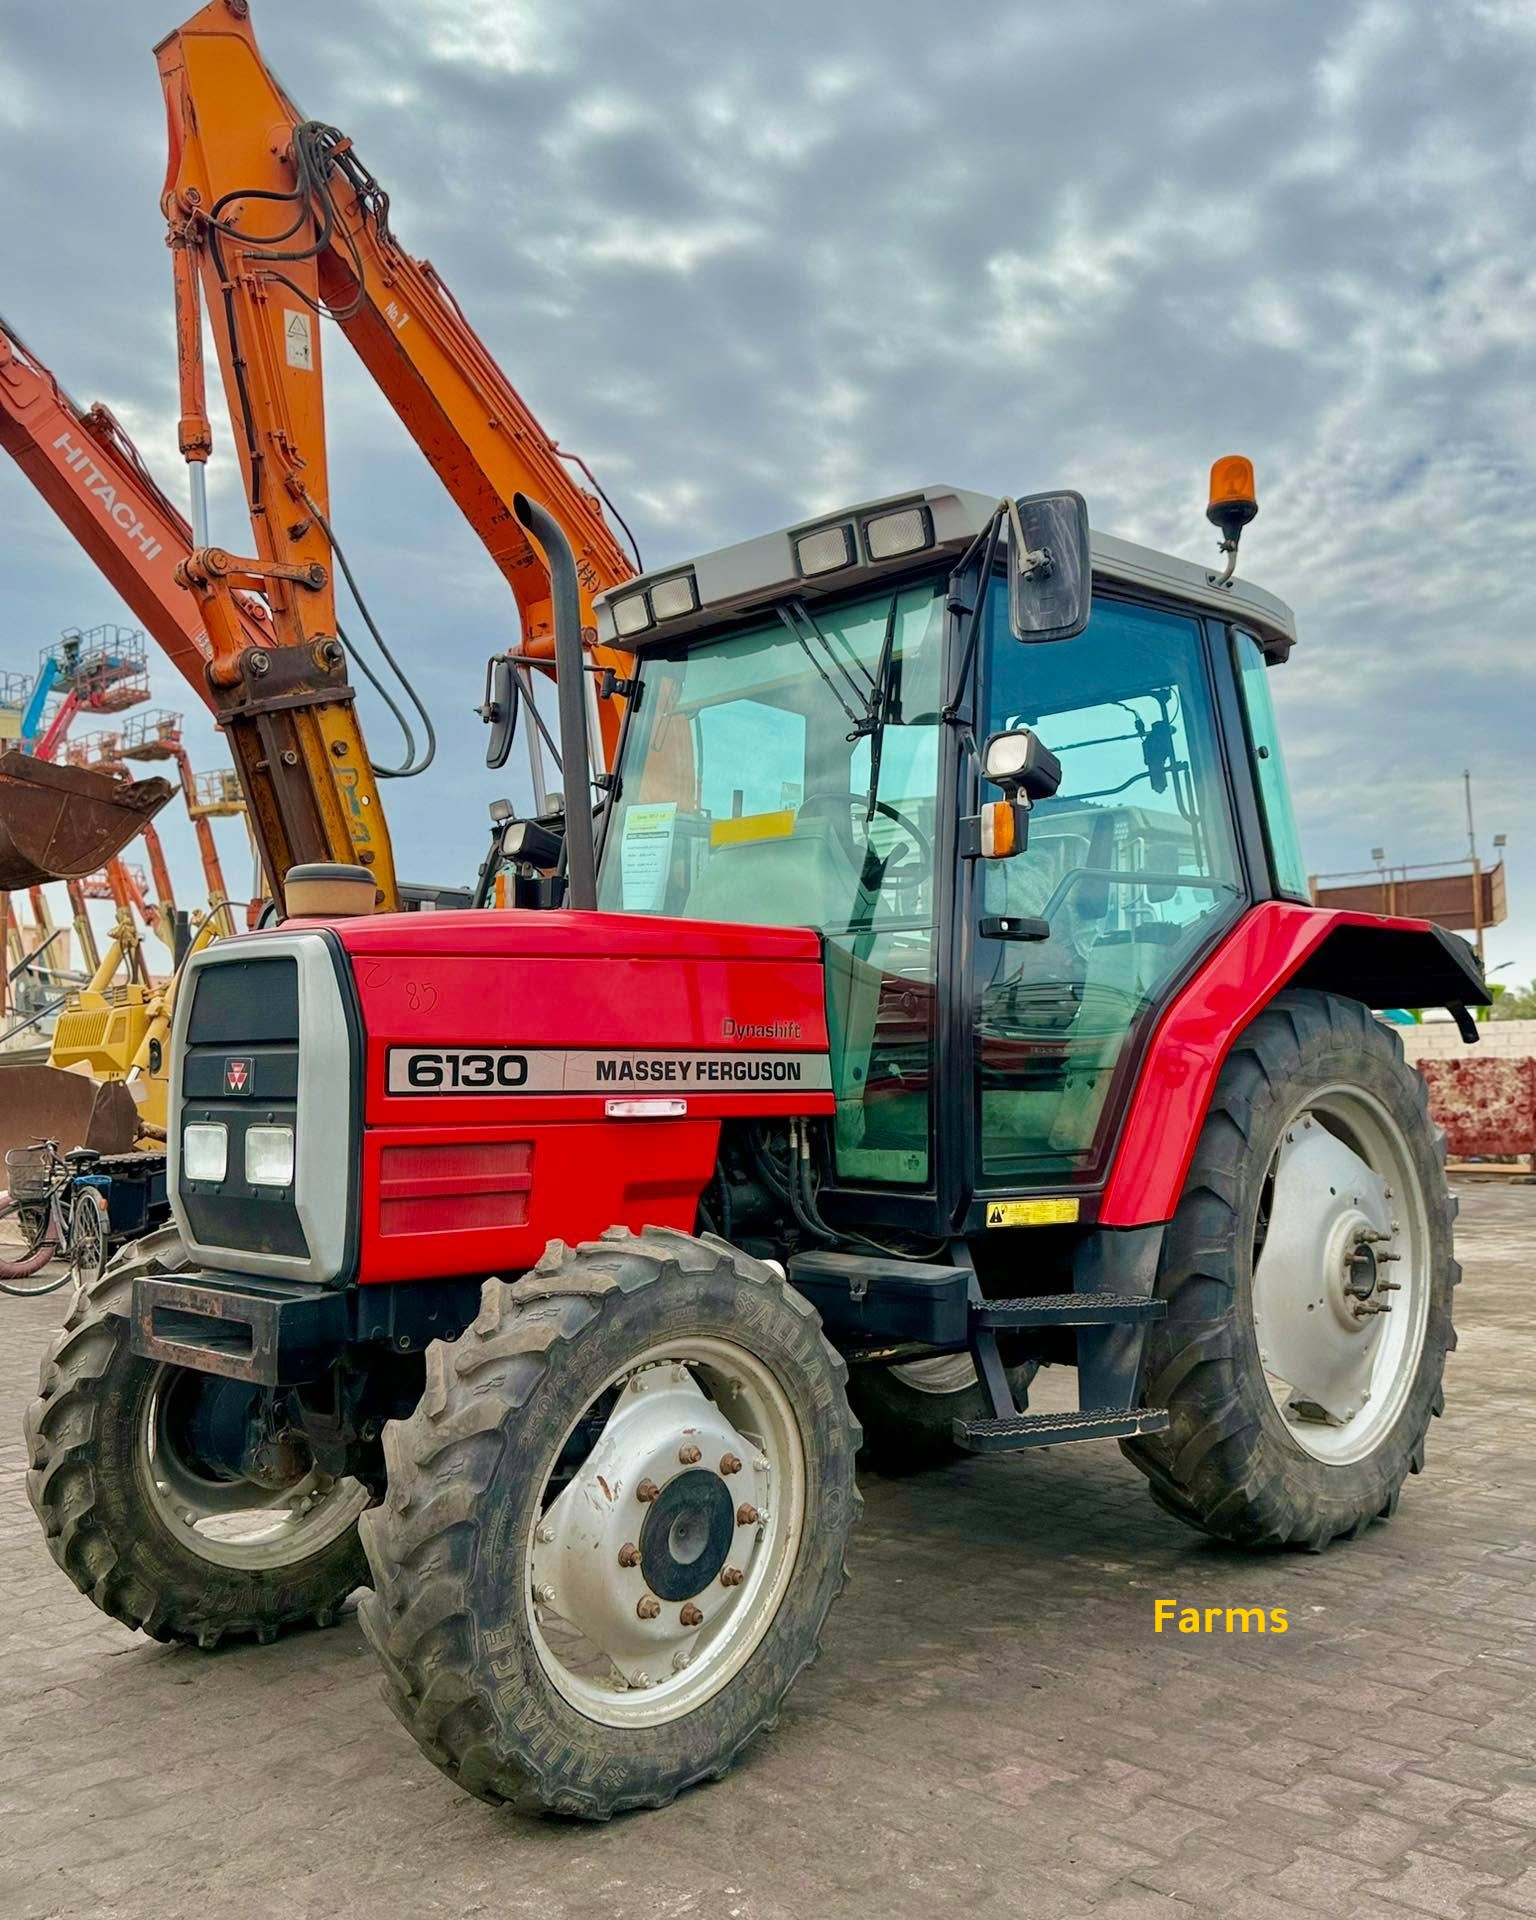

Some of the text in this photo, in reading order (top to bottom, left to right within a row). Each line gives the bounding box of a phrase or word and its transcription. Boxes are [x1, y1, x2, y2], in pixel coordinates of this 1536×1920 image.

[52, 432, 162, 560] HITACHI
[723, 1018, 801, 1042] Dynashift
[408, 1054, 528, 1087] 6130
[596, 1060, 801, 1081] MASSEY FERGUSON
[745, 1302, 844, 1449] ALLIANCE
[483, 1624, 613, 1784] ALLIANCE
